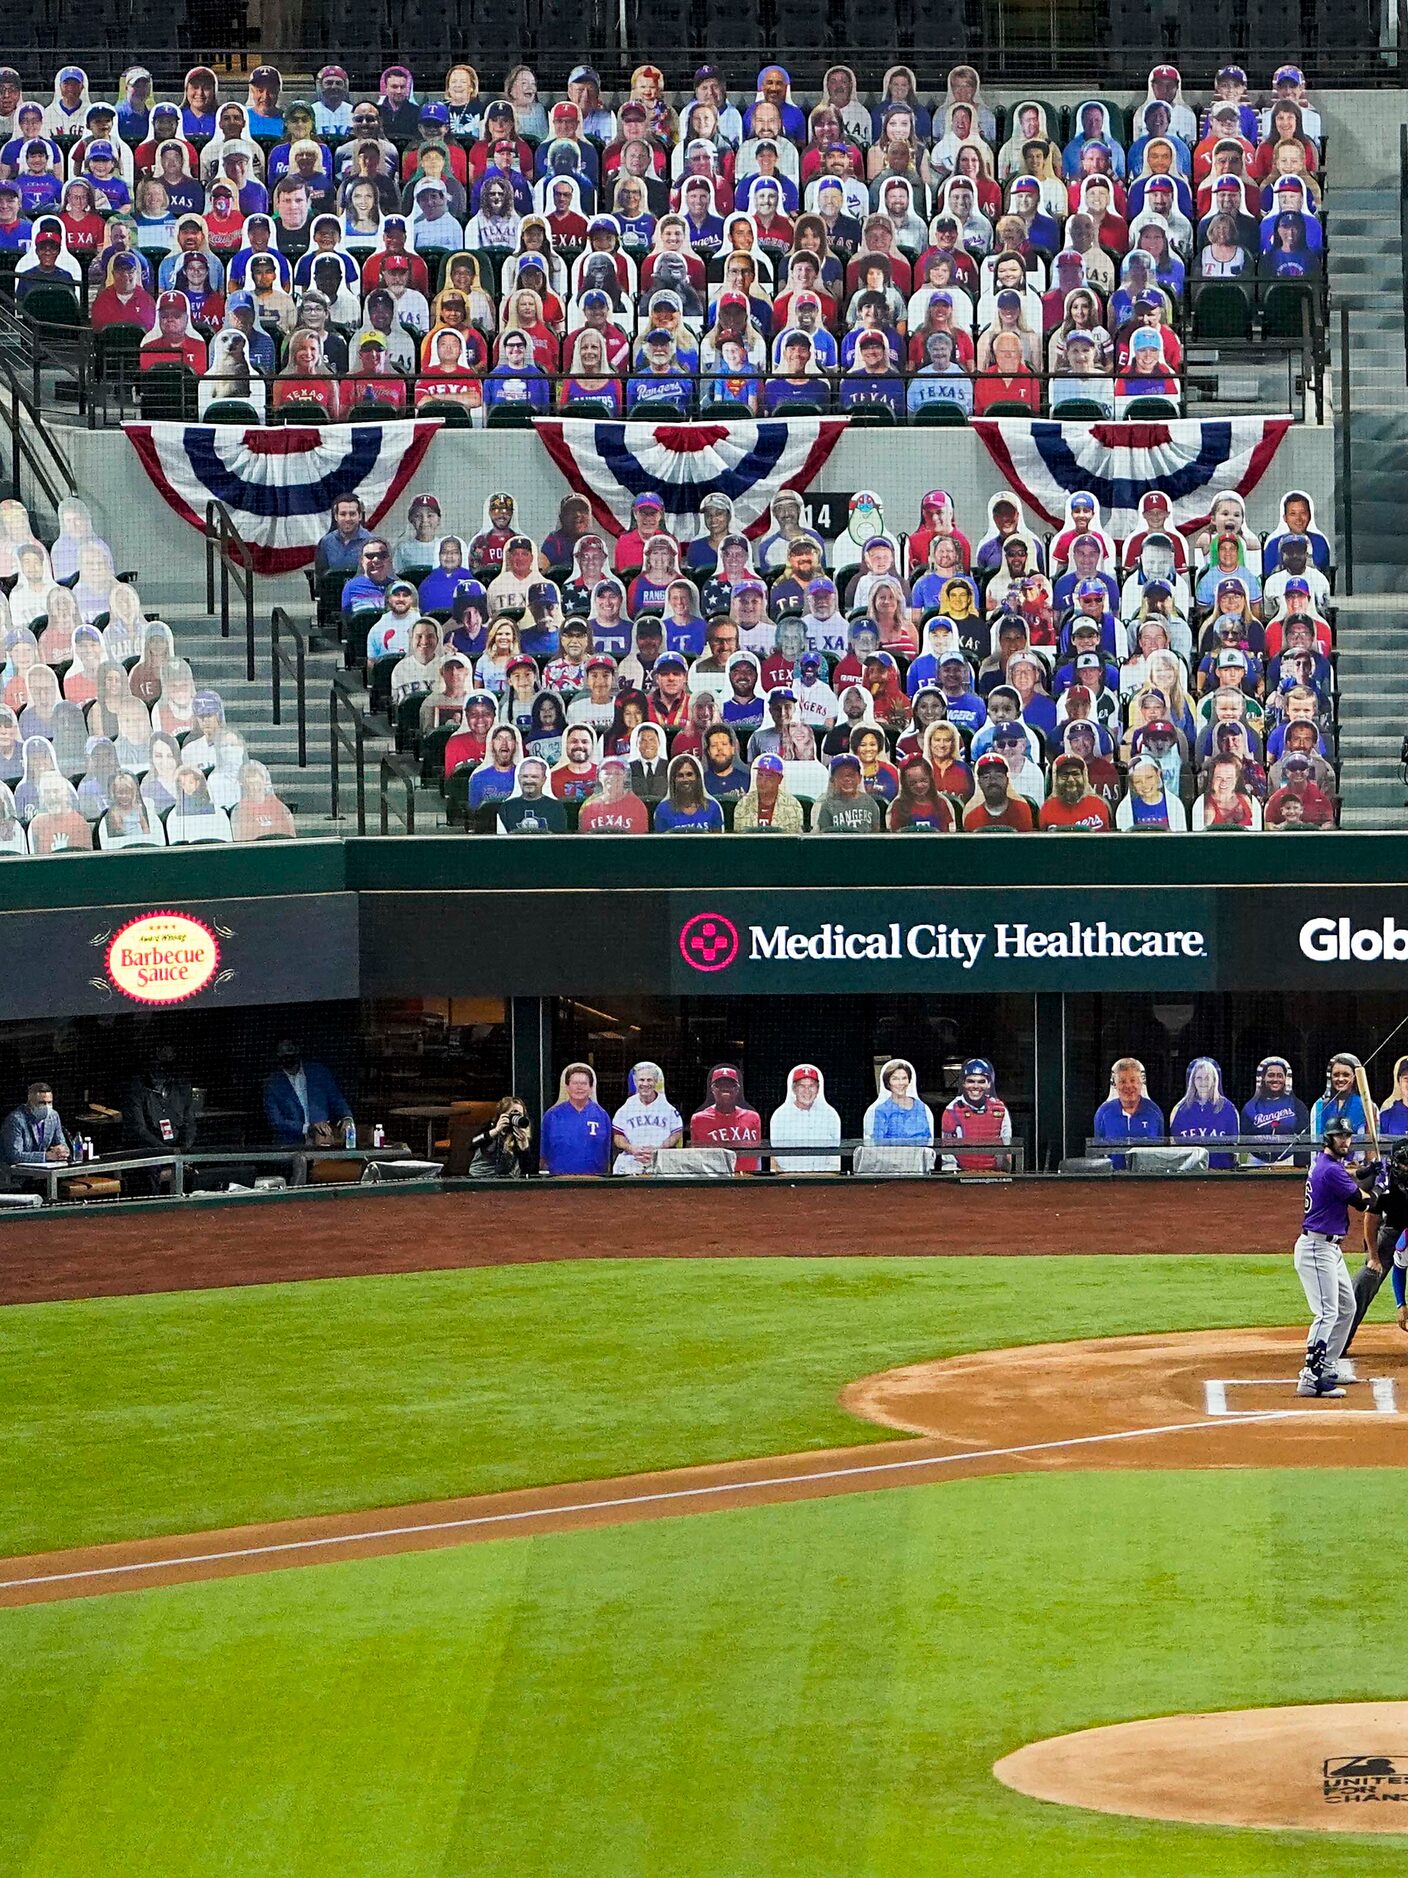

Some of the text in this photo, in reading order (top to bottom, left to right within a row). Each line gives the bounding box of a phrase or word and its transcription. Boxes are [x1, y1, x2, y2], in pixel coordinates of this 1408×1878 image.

[428, 104, 437, 113] T
[33, 192, 42, 201] T
[171, 196, 193, 207] XAS
[68, 233, 94, 244] EXA
[1206, 263, 1215, 275] T
[168, 292, 176, 302] T
[1142, 289, 1151, 298] T
[187, 354, 194, 362] T
[254, 354, 263, 363] T
[286, 389, 325, 402] TEXAS
[636, 381, 682, 400] Rangers
[919, 386, 965, 400] TEXAS
[1019, 389, 1026, 397] T
[423, 496, 430, 504] T
[464, 582, 470, 592] T
[674, 636, 690, 652] T
[477, 695, 484, 703] T
[1000, 722, 1009, 730] T
[1156, 722, 1164, 730] T
[833, 807, 873, 824] RANGERS
[591, 816, 633, 830] TEXAS
[760, 818, 770, 827] T
[847, 818, 861, 828] T
[749, 922, 1204, 968] Medical City Healthcare
[121, 946, 205, 966] Barbecue
[137, 966, 188, 988] Sauce
[802, 1068, 812, 1076] T
[626, 1116, 667, 1129] TEXAS
[1254, 1108, 1296, 1127] Rangers
[588, 1122, 600, 1136] T
[708, 1128, 757, 1142] TEXAS
[1323, 1786, 1377, 1794] FOR
